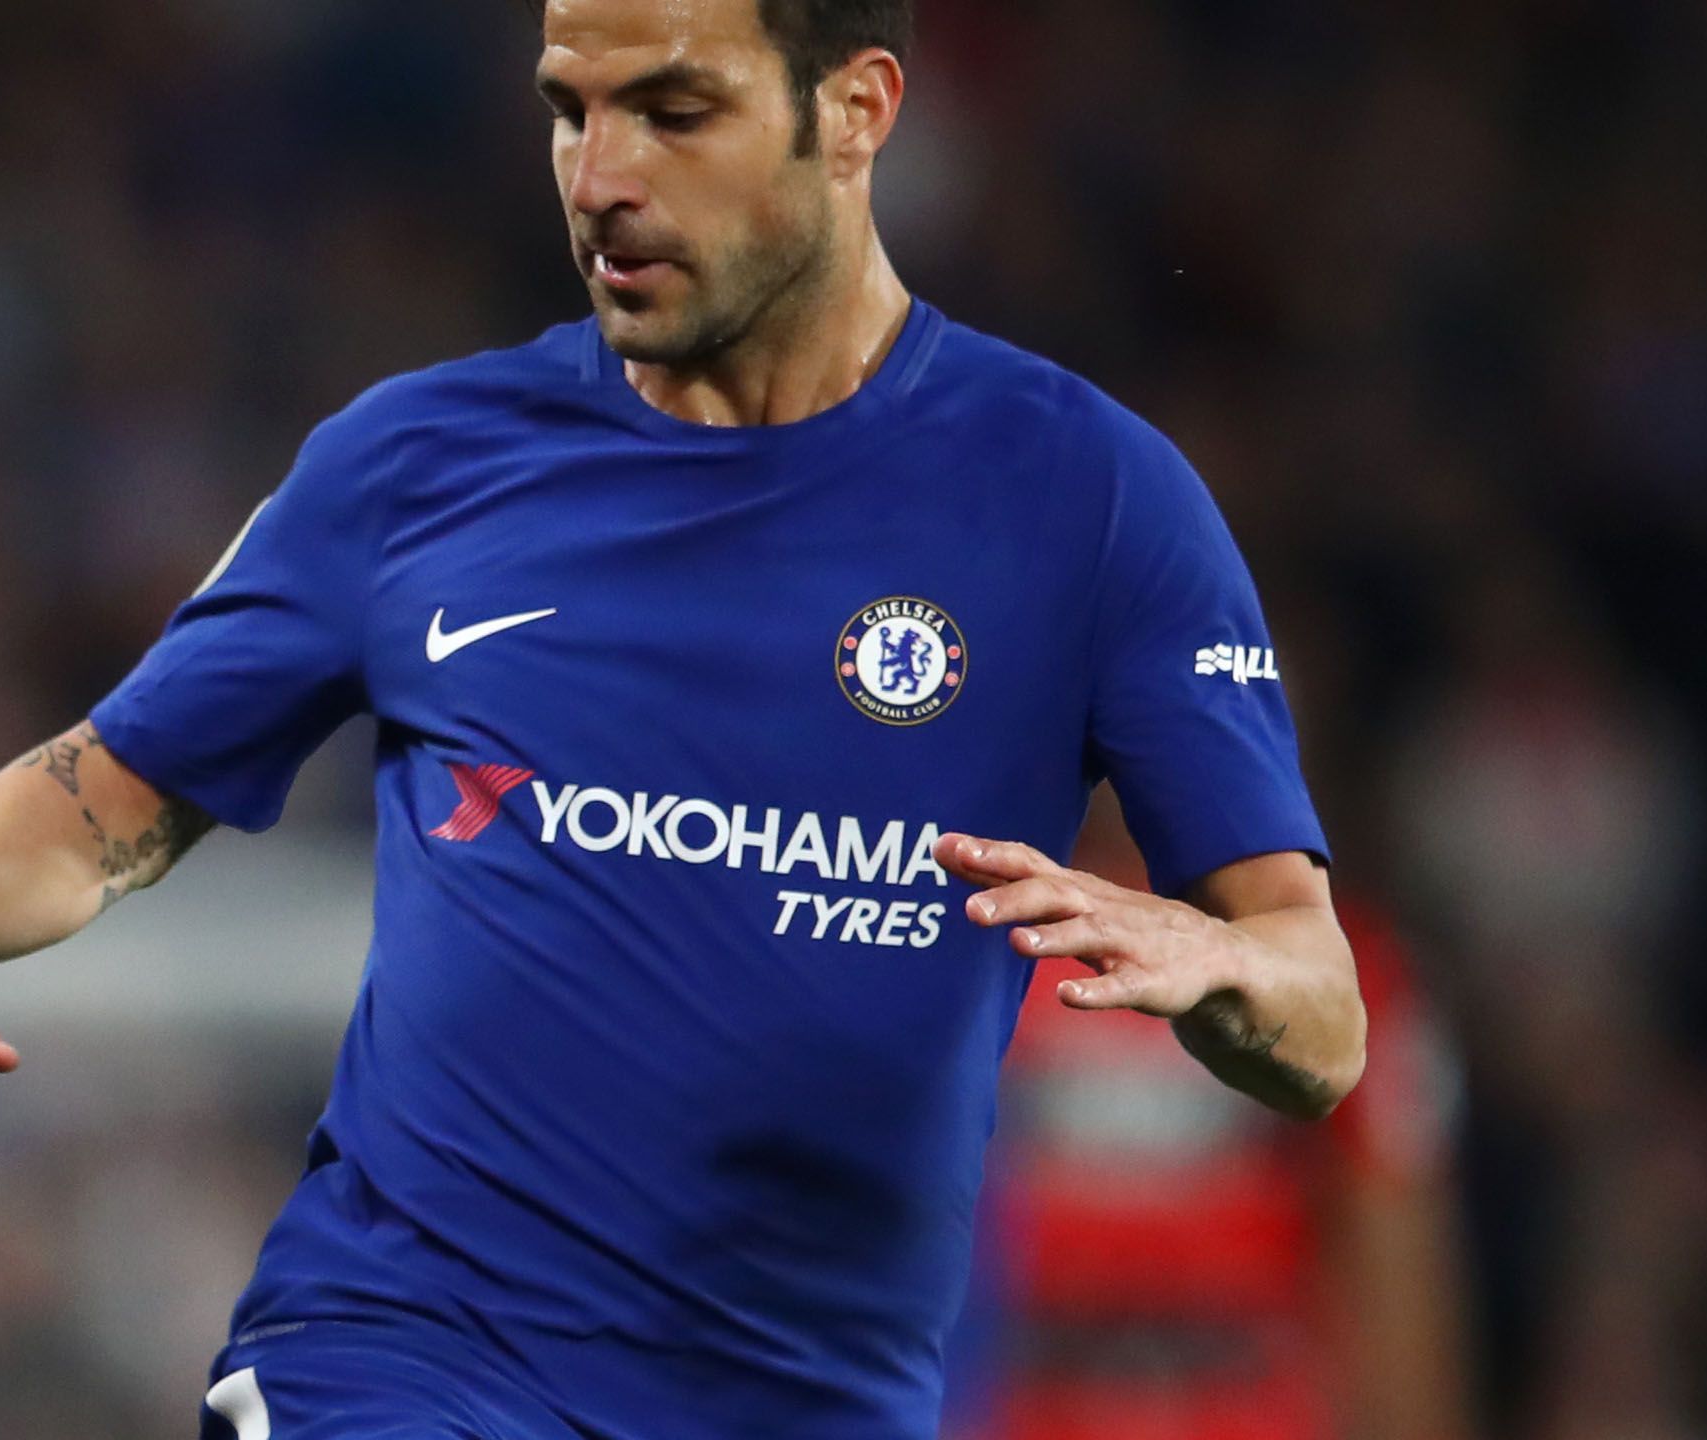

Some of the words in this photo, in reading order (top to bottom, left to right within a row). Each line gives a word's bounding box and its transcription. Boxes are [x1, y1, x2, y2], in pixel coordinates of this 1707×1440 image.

[862, 601, 946, 633] CHELSEA
[1232, 644, 1280, 686] ALL
[854, 690, 908, 718] FOOTBALL
[913, 697, 941, 717] CLUB
[531, 780, 948, 886] YOKOHAMA
[772, 890, 946, 948] TYRES
